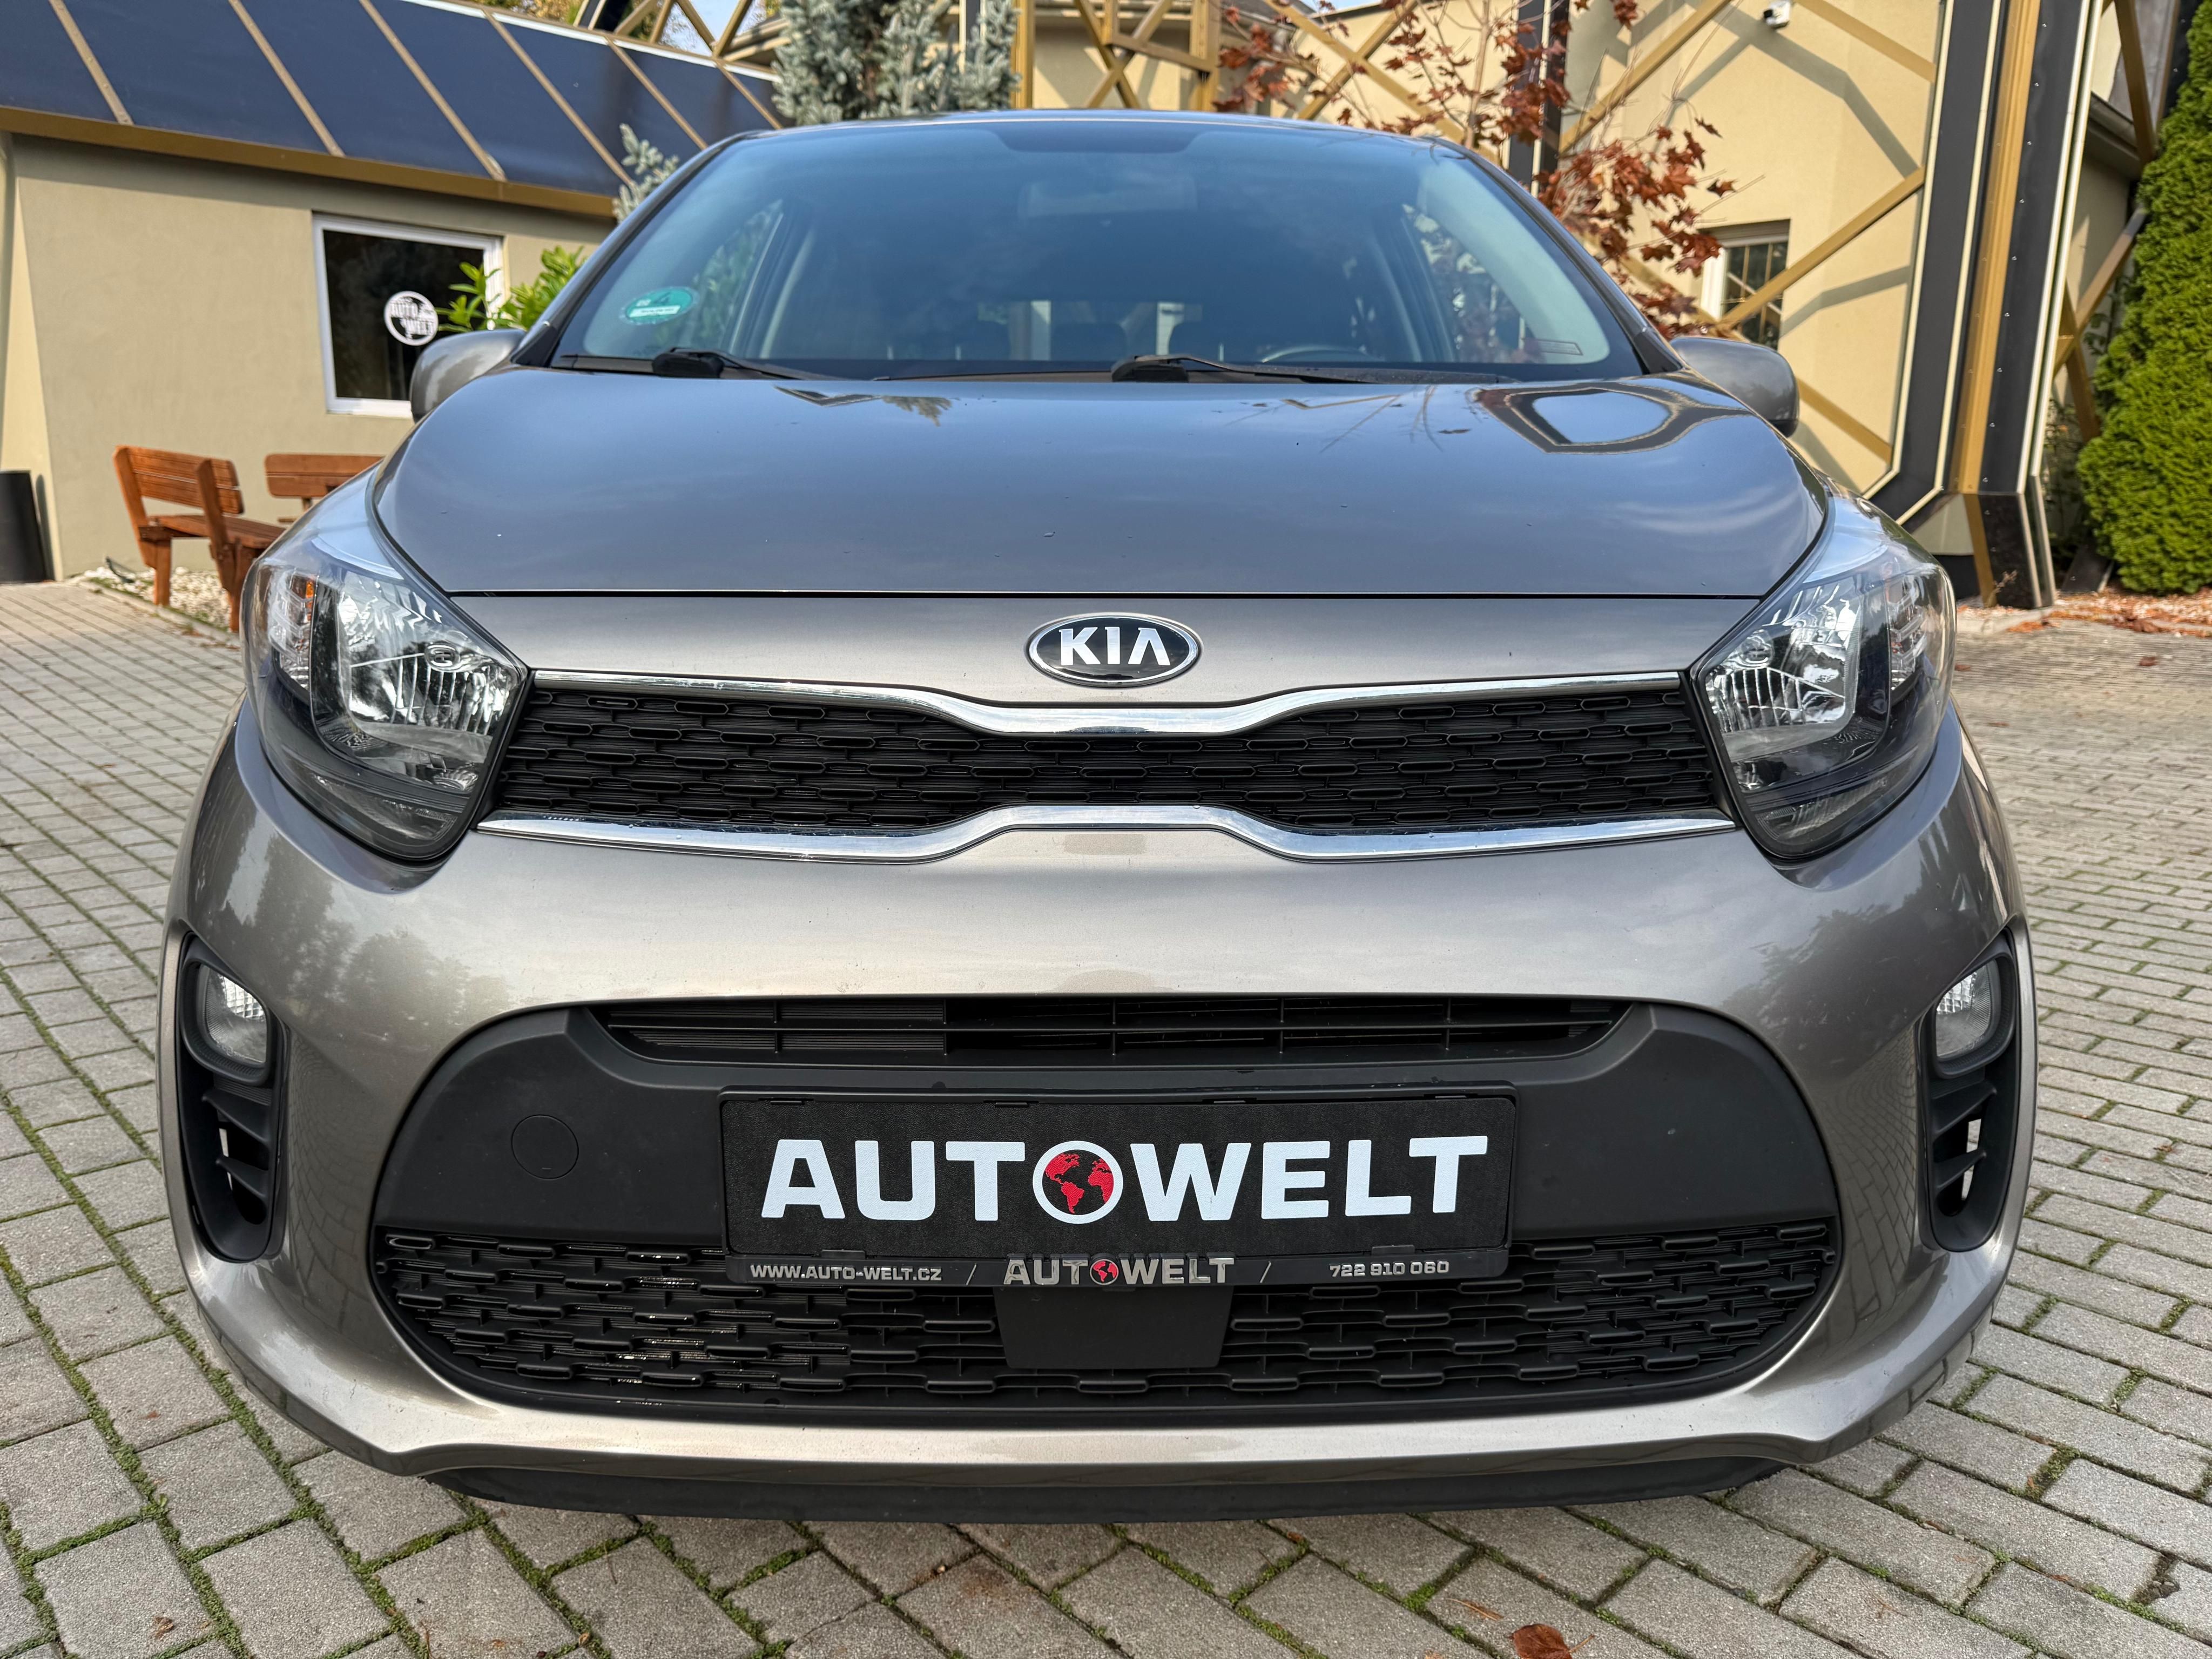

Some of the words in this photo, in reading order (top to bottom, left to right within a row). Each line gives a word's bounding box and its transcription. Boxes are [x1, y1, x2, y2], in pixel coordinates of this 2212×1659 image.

[1058, 626, 1170, 666] KIA
[760, 1135, 1488, 1224] AUTOWELT
[750, 1264, 942, 1281] WWW.AUTO-WELT.CZ
[1003, 1257, 1235, 1286] AUTOWELT
[1329, 1264, 1366, 1277] 722
[1370, 1262, 1405, 1276] 910
[1410, 1260, 1449, 1274] 060
